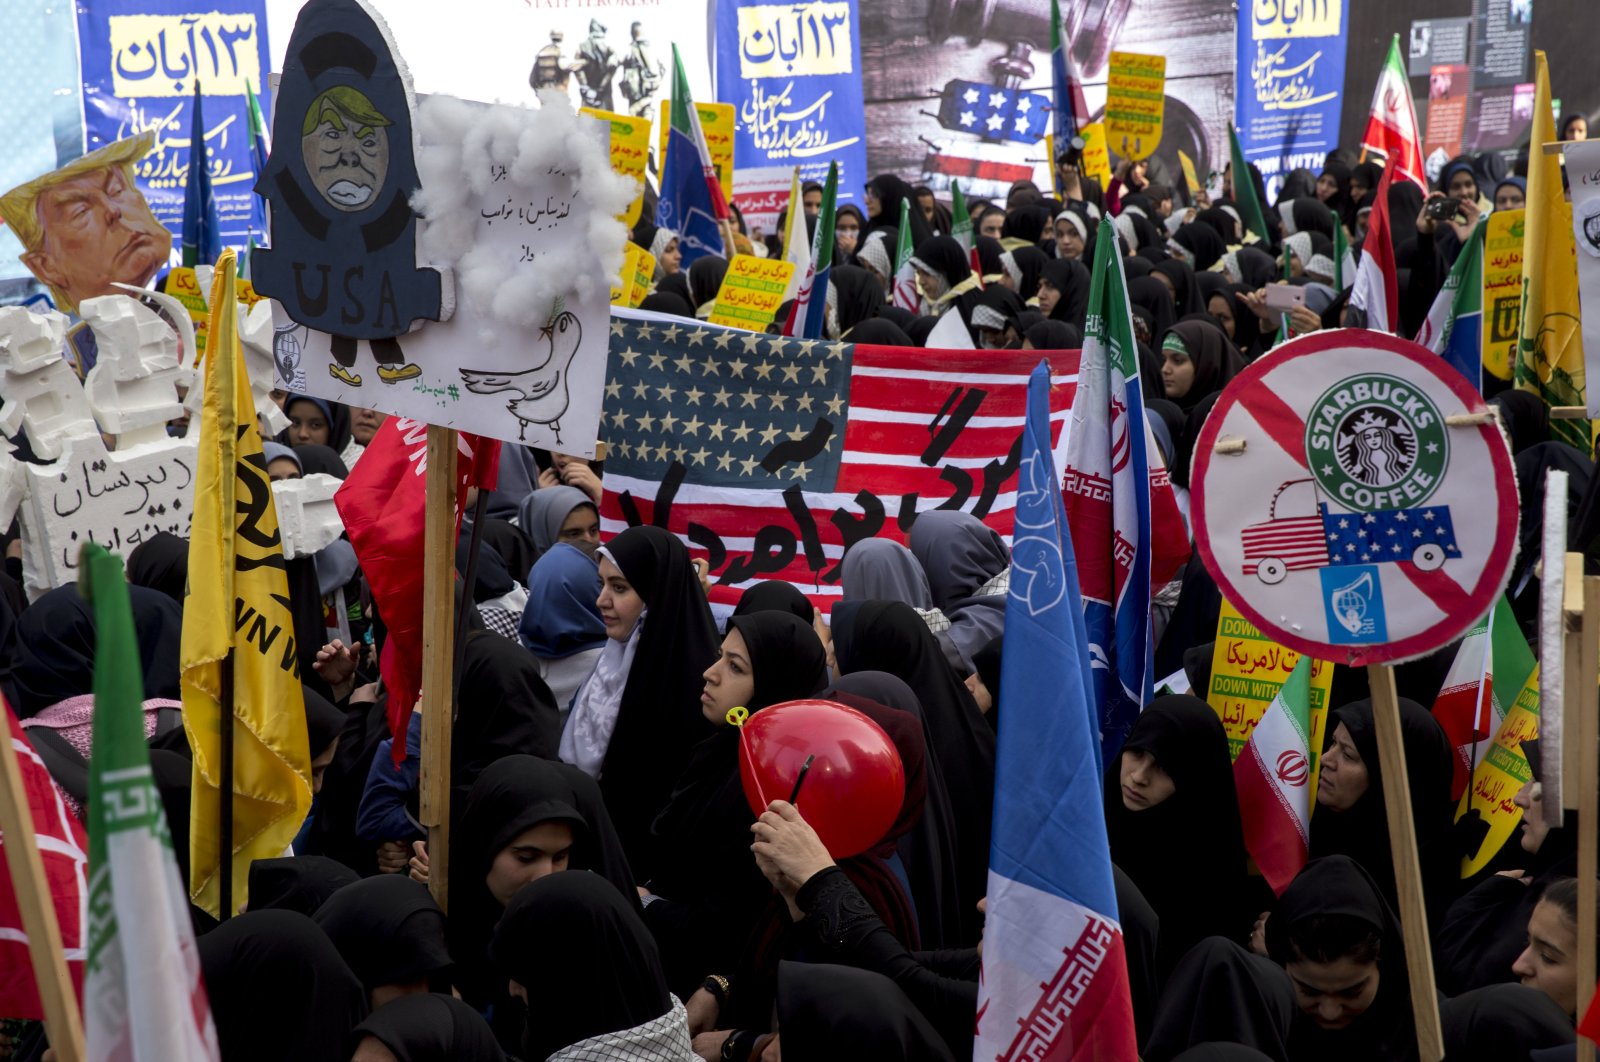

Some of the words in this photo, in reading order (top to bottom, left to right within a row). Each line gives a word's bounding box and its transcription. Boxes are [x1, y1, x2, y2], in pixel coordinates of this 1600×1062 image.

[116, 18, 201, 93] آبان
[743, 6, 808, 72] آبان
[292, 262, 401, 332] USA
[1501, 300, 1521, 309] DOW
[1311, 381, 1435, 450] STARBUCKS
[1339, 467, 1434, 510] COFFEE
[1226, 640, 1280, 674] لامریکا
[1214, 677, 1250, 696] DOWN
[1251, 680, 1281, 700] WITH
